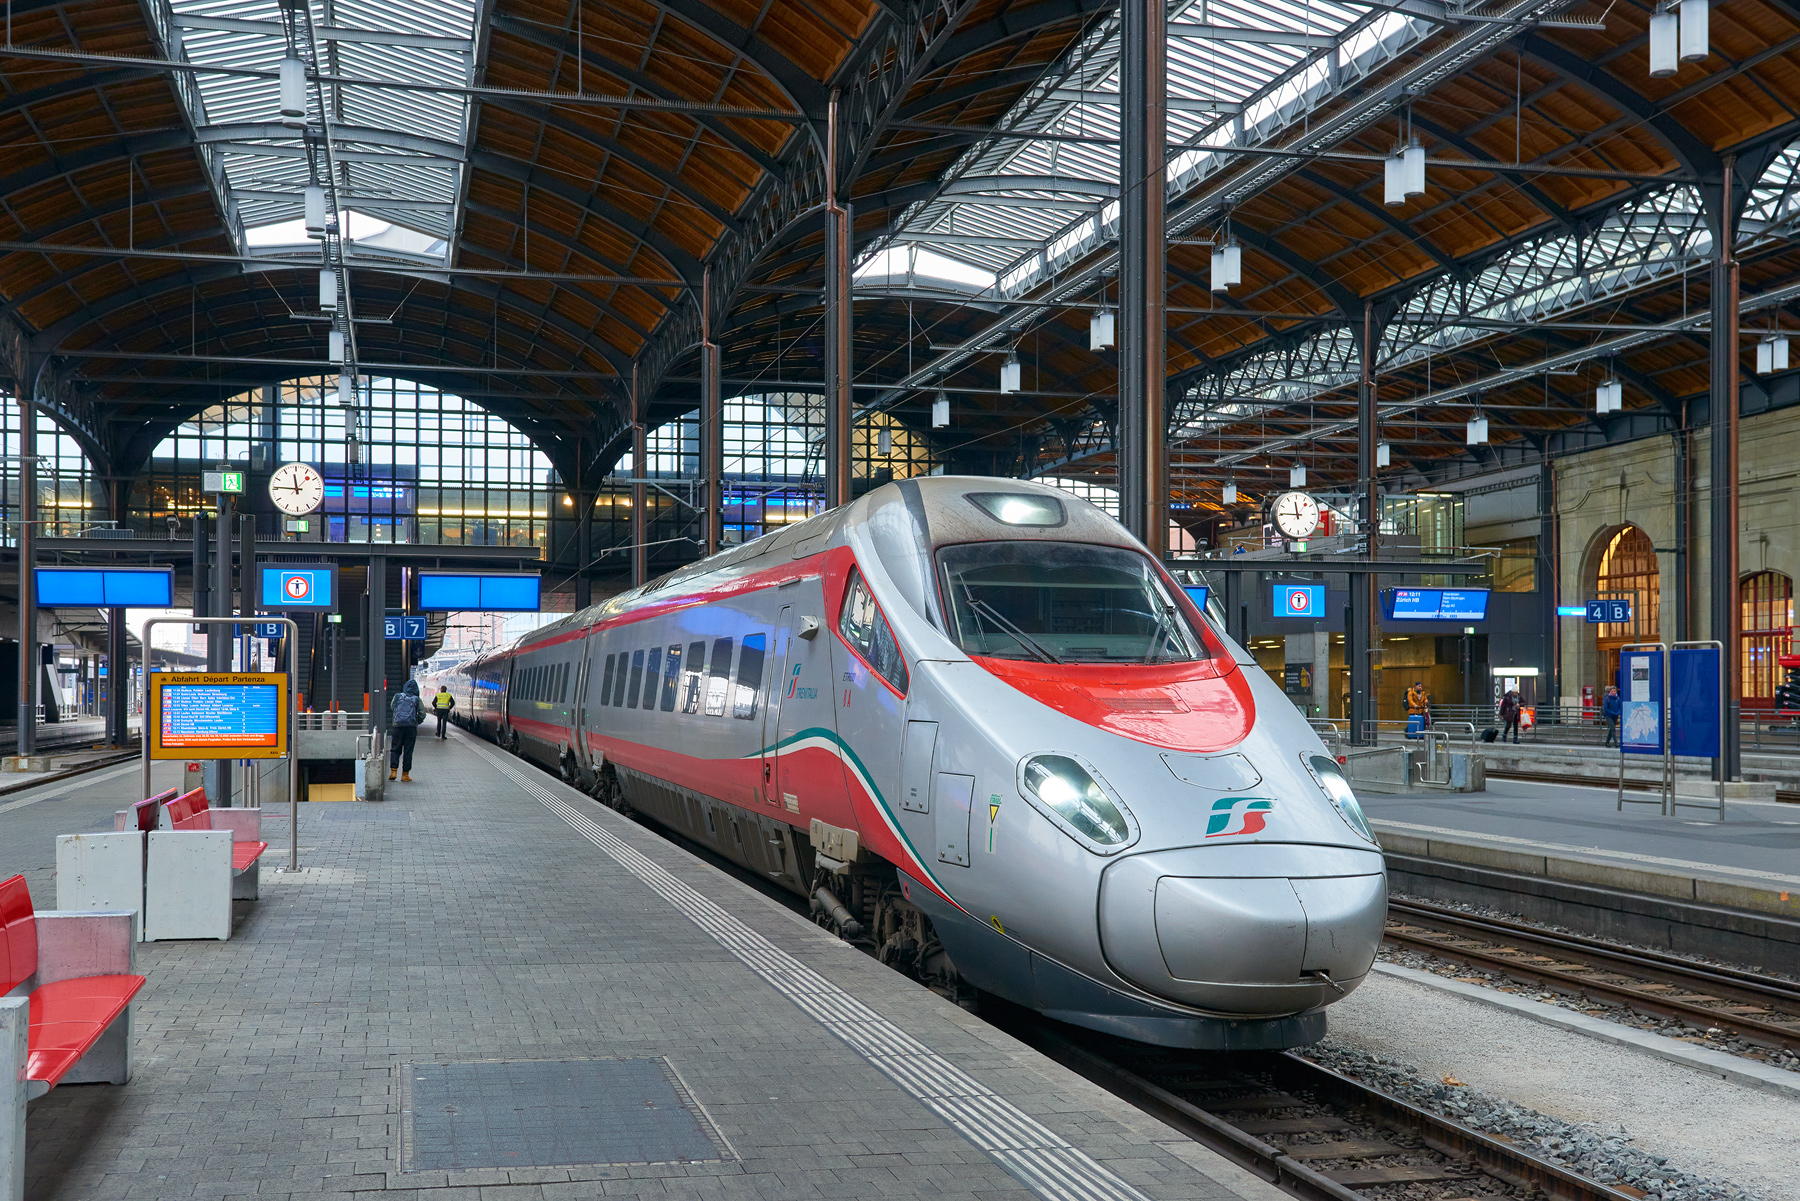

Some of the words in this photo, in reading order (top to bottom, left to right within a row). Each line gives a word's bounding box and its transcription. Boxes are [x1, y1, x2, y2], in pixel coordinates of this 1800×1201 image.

[1593, 607, 1602, 619] 4
[1614, 607, 1623, 619] B
[266, 623, 277, 635] B
[385, 623, 396, 636] B
[410, 623, 420, 636] 7
[203, 675, 229, 684] Départ
[232, 675, 265, 683] Partenza
